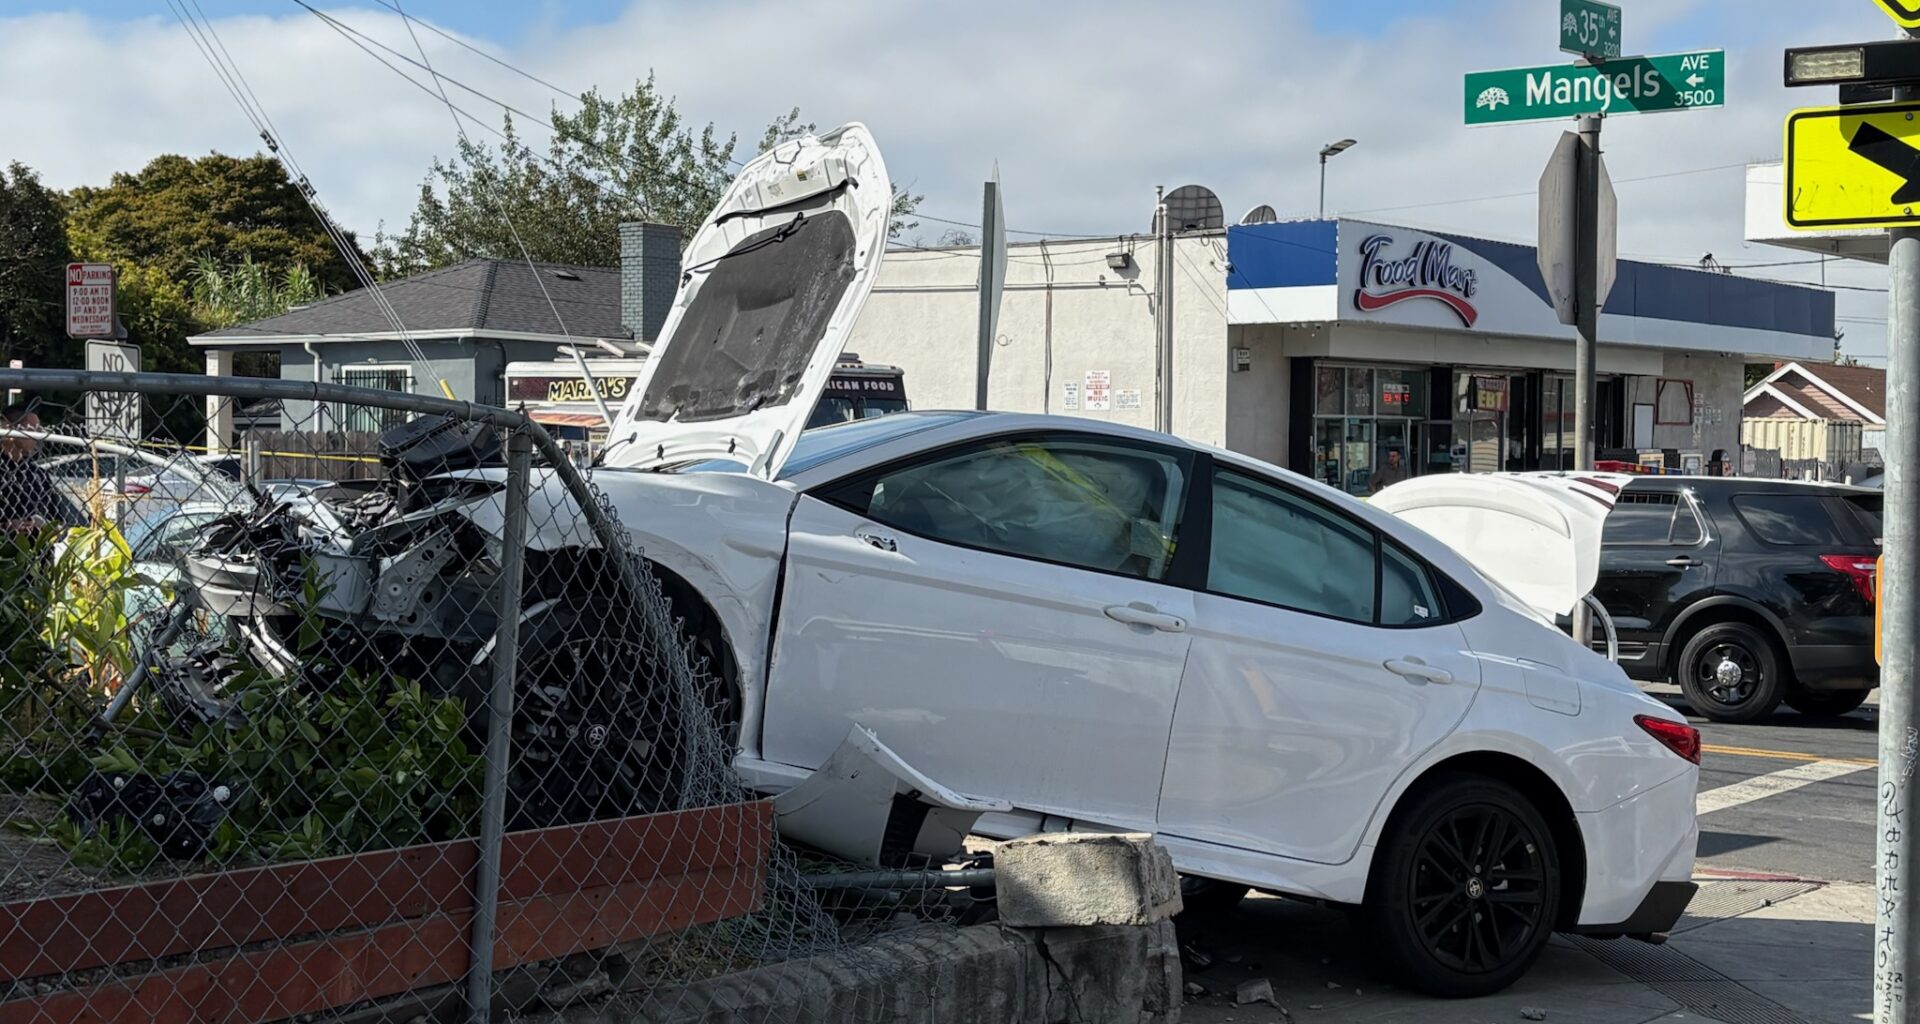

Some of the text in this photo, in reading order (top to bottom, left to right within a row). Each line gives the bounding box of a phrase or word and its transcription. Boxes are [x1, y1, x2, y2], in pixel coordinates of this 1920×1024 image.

[1604, 41, 1620, 58] 3200
[1526, 54, 1710, 111] Mangels AVE
[1674, 89, 1715, 107] 3500
[1360, 234, 1478, 298] Food Mart
[69, 268, 112, 282] NO PARKING
[90, 287, 99, 296] AM
[101, 287, 109, 296] TO
[91, 297, 109, 305] NOON
[84, 306, 97, 314] AND
[103, 352, 124, 372] NO
[863, 381, 895, 391] FOOD
[1477, 390, 1504, 409] EBT
[1893, 971, 1903, 1002] RIP
